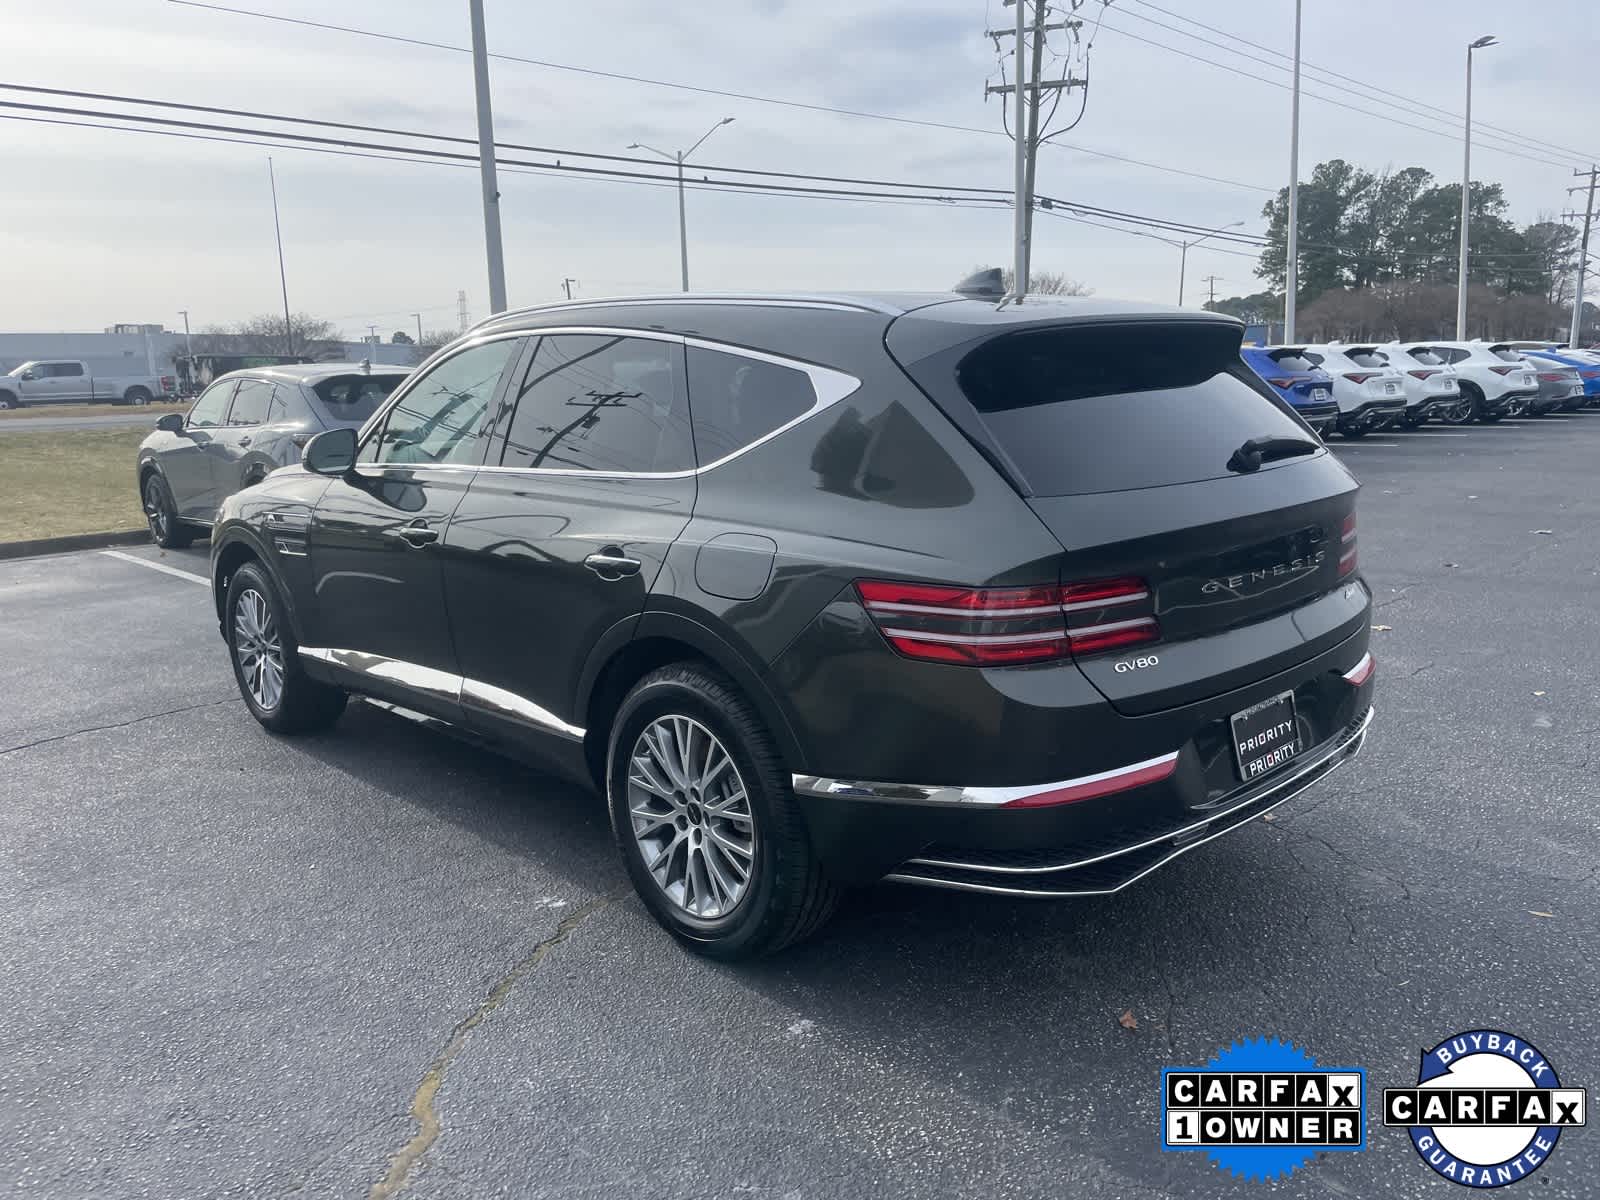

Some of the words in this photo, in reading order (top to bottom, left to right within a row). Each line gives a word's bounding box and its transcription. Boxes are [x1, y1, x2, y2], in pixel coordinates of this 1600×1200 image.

[1201, 550, 1326, 594] GENESIS
[1114, 655, 1159, 673] GV80
[1239, 719, 1292, 755] PRIORITY
[1249, 742, 1295, 776] PRIORITY
